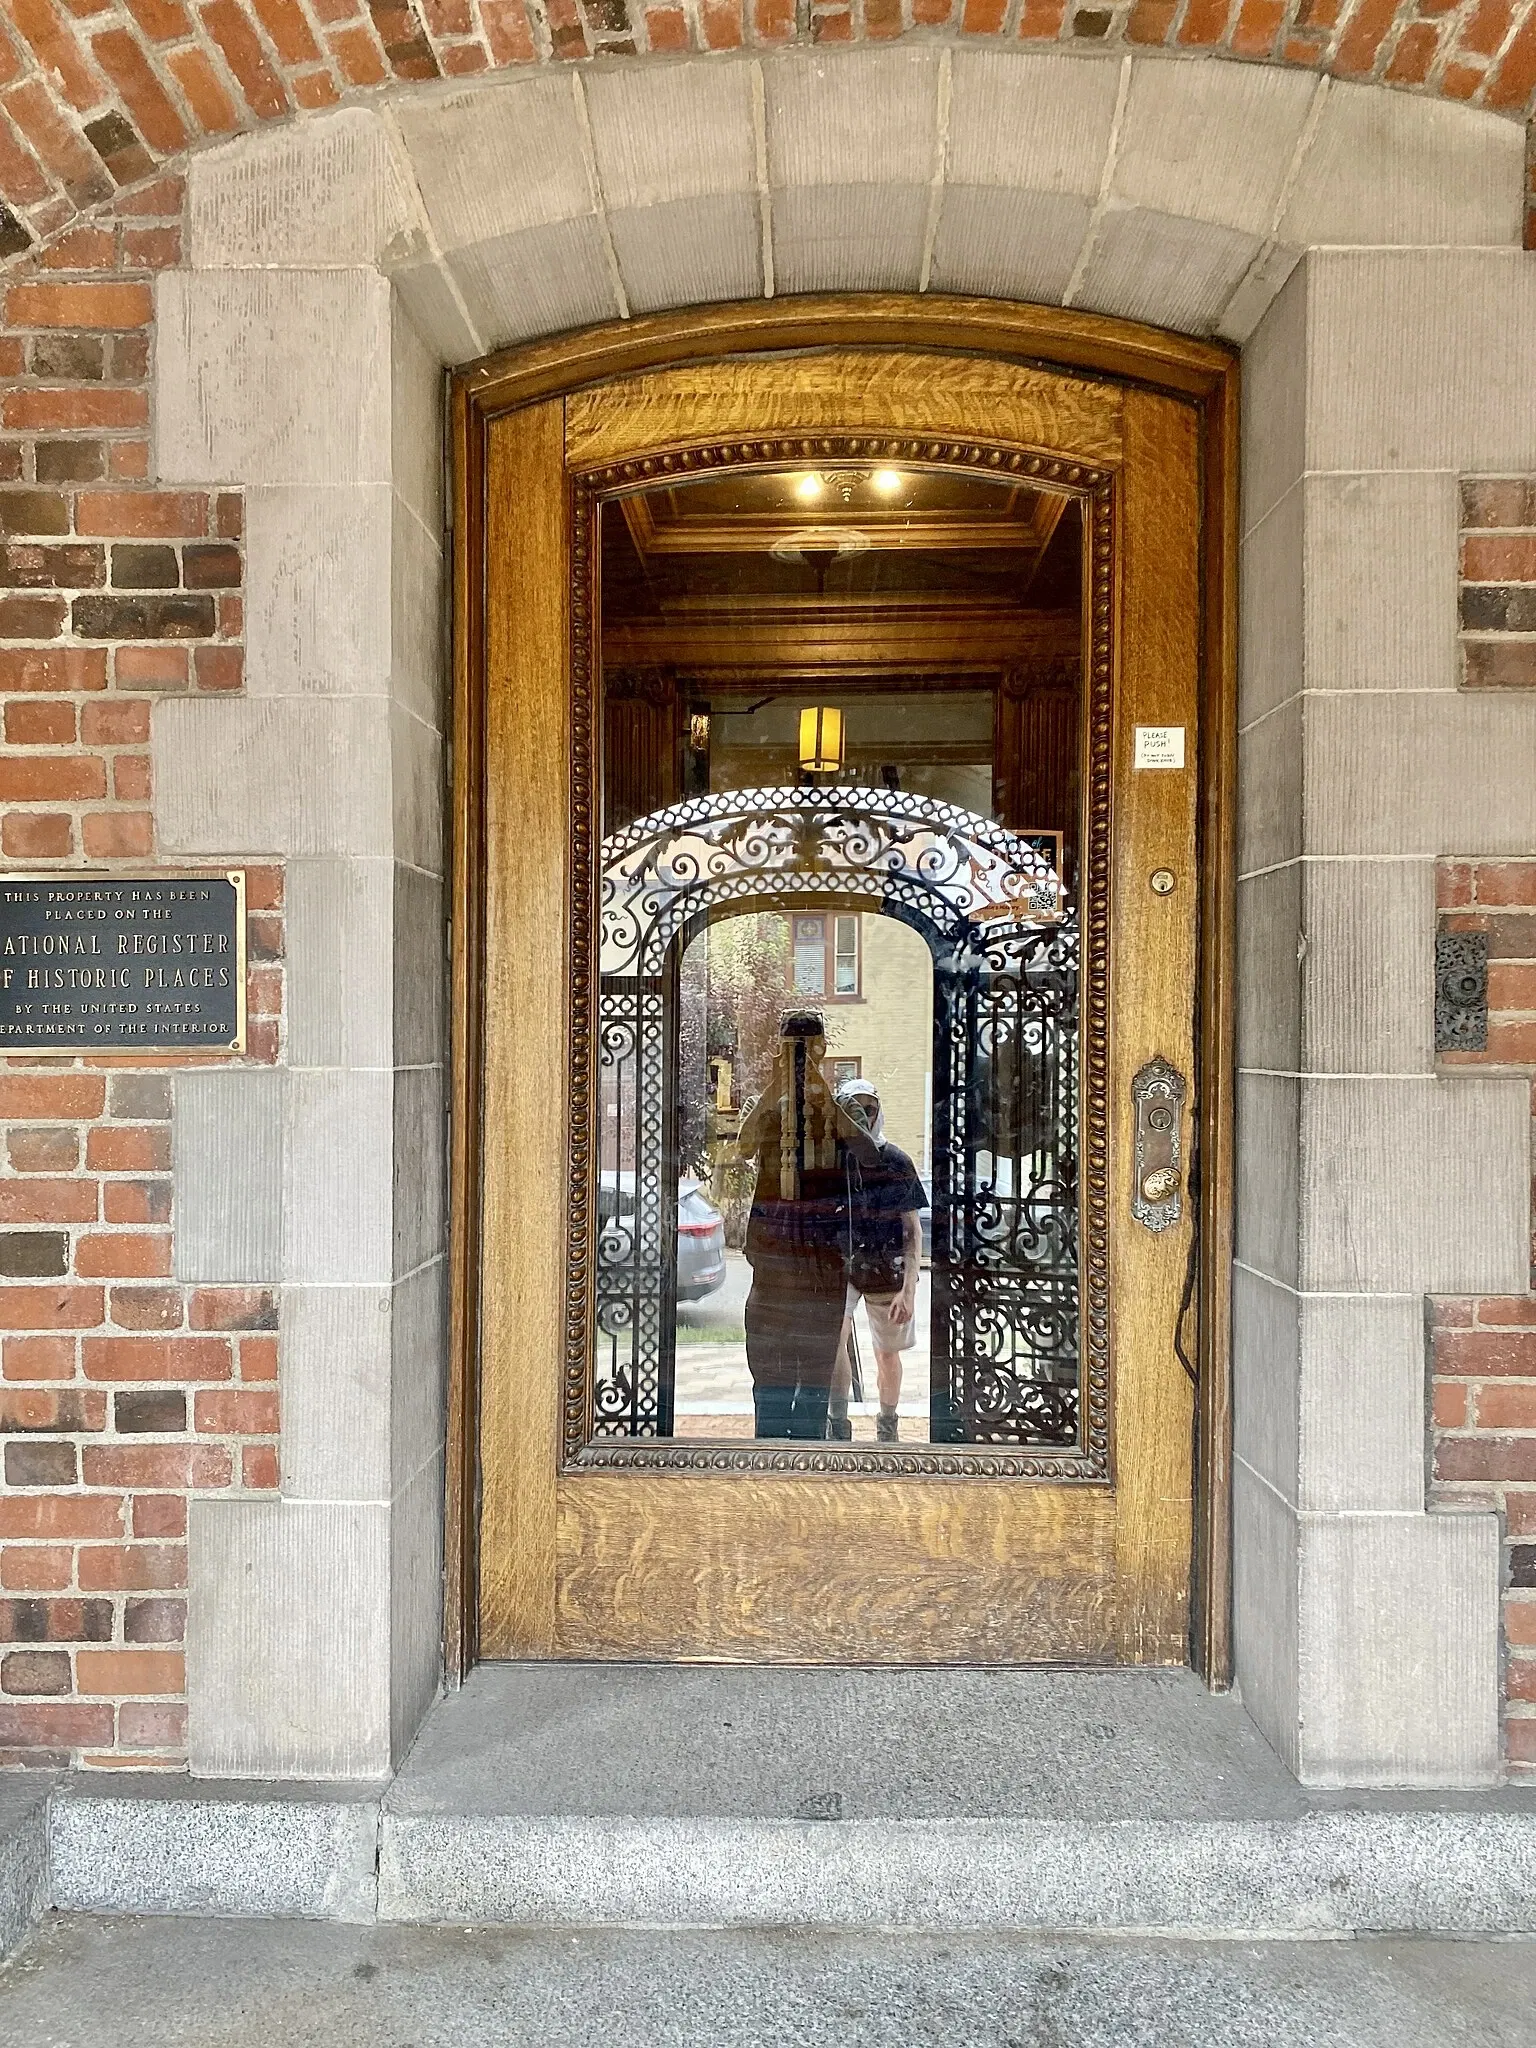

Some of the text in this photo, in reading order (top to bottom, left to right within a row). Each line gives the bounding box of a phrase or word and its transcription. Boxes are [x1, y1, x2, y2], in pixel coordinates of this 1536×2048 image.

[1143, 731, 1167, 739] PLEASE
[4, 890, 210, 902] THIS PROPERTY HAS BEEN
[45, 909, 173, 920] PLACED ON THE
[3, 934, 230, 955] ATIONAL REGISTER
[3, 967, 230, 989] F HISTORIC PLACES
[15, 1003, 202, 1014] BY THE UNITED STATES
[0, 1023, 229, 1034] EPARTMENT OF THE INTERIOR
